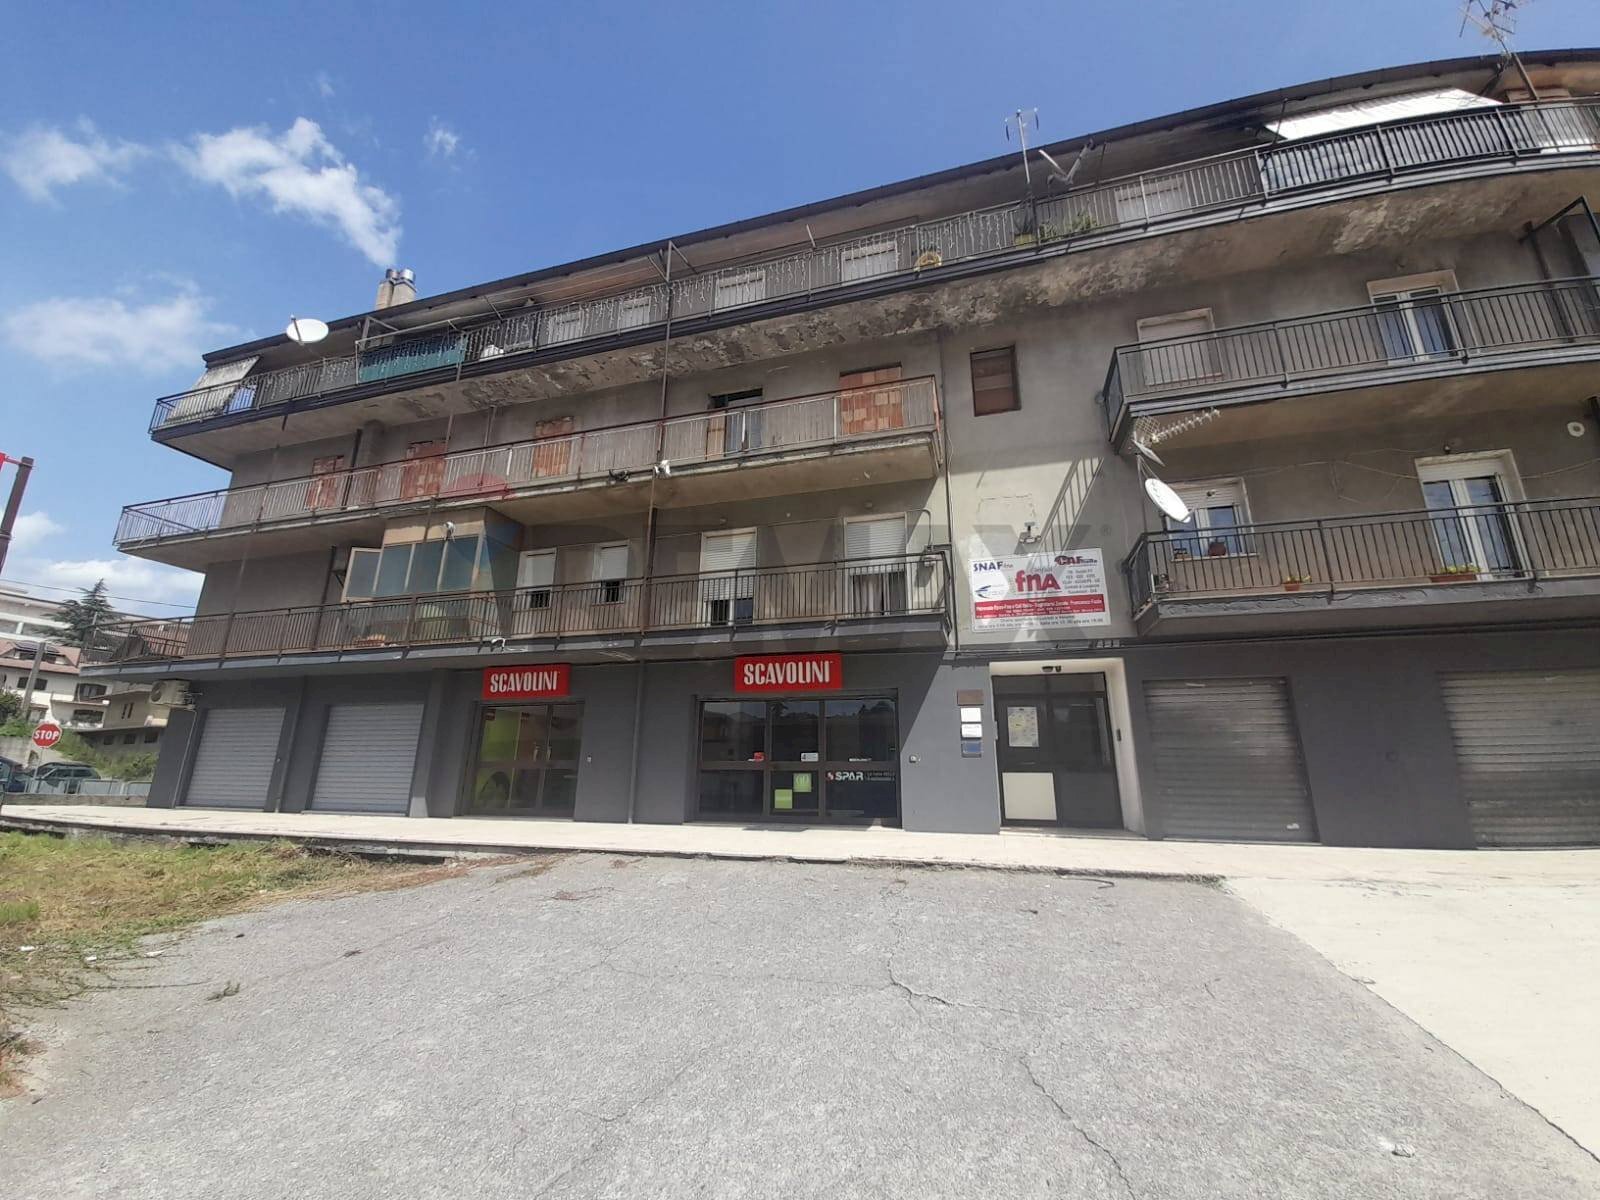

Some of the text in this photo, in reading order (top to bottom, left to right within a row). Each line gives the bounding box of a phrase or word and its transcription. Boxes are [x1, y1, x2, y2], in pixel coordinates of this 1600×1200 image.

[973, 561, 1003, 572] SNAF
[743, 660, 830, 685] SCAVOLINI
[489, 671, 558, 693] SCAVOLINI
[33, 729, 60, 741] STOP
[835, 771, 864, 781] SPAR
